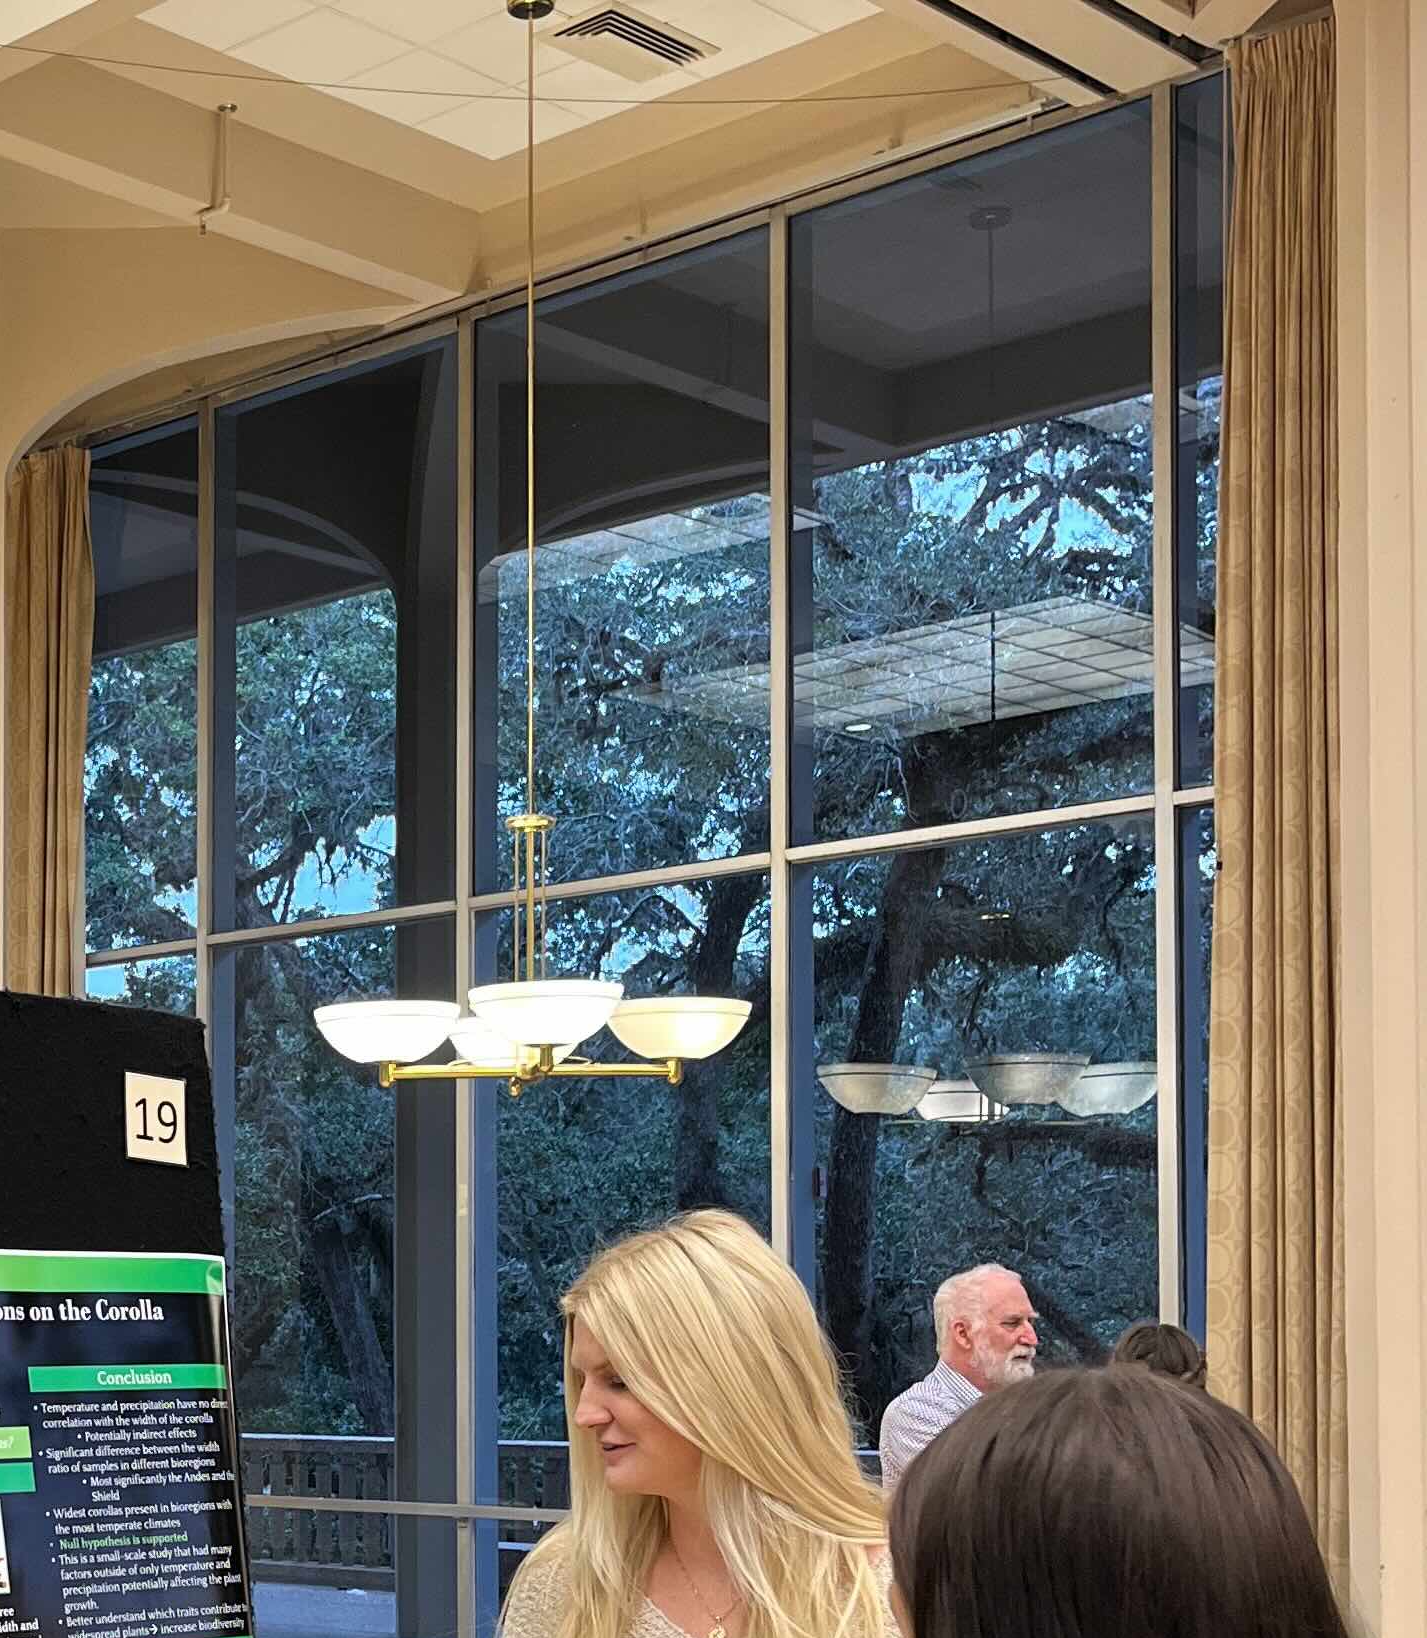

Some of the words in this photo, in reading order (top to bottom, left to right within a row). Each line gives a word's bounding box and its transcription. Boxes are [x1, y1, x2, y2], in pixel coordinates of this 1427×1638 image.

[135, 1097, 178, 1144] 19
[29, 1306, 55, 1321] on
[58, 1298, 91, 1321] the
[95, 1298, 164, 1320] Corolla
[96, 1369, 172, 1385] Conclusion
[42, 1416, 92, 1428] correlation
[93, 1415, 114, 1426] with
[114, 1415, 130, 1426] the
[131, 1414, 157, 1425] width
[158, 1413, 168, 1424] of
[168, 1413, 183, 1424] the
[184, 1412, 214, 1424] corolla
[84, 1429, 131, 1442] Potentially
[132, 1429, 167, 1440] indirect
[167, 1427, 197, 1438] effects
